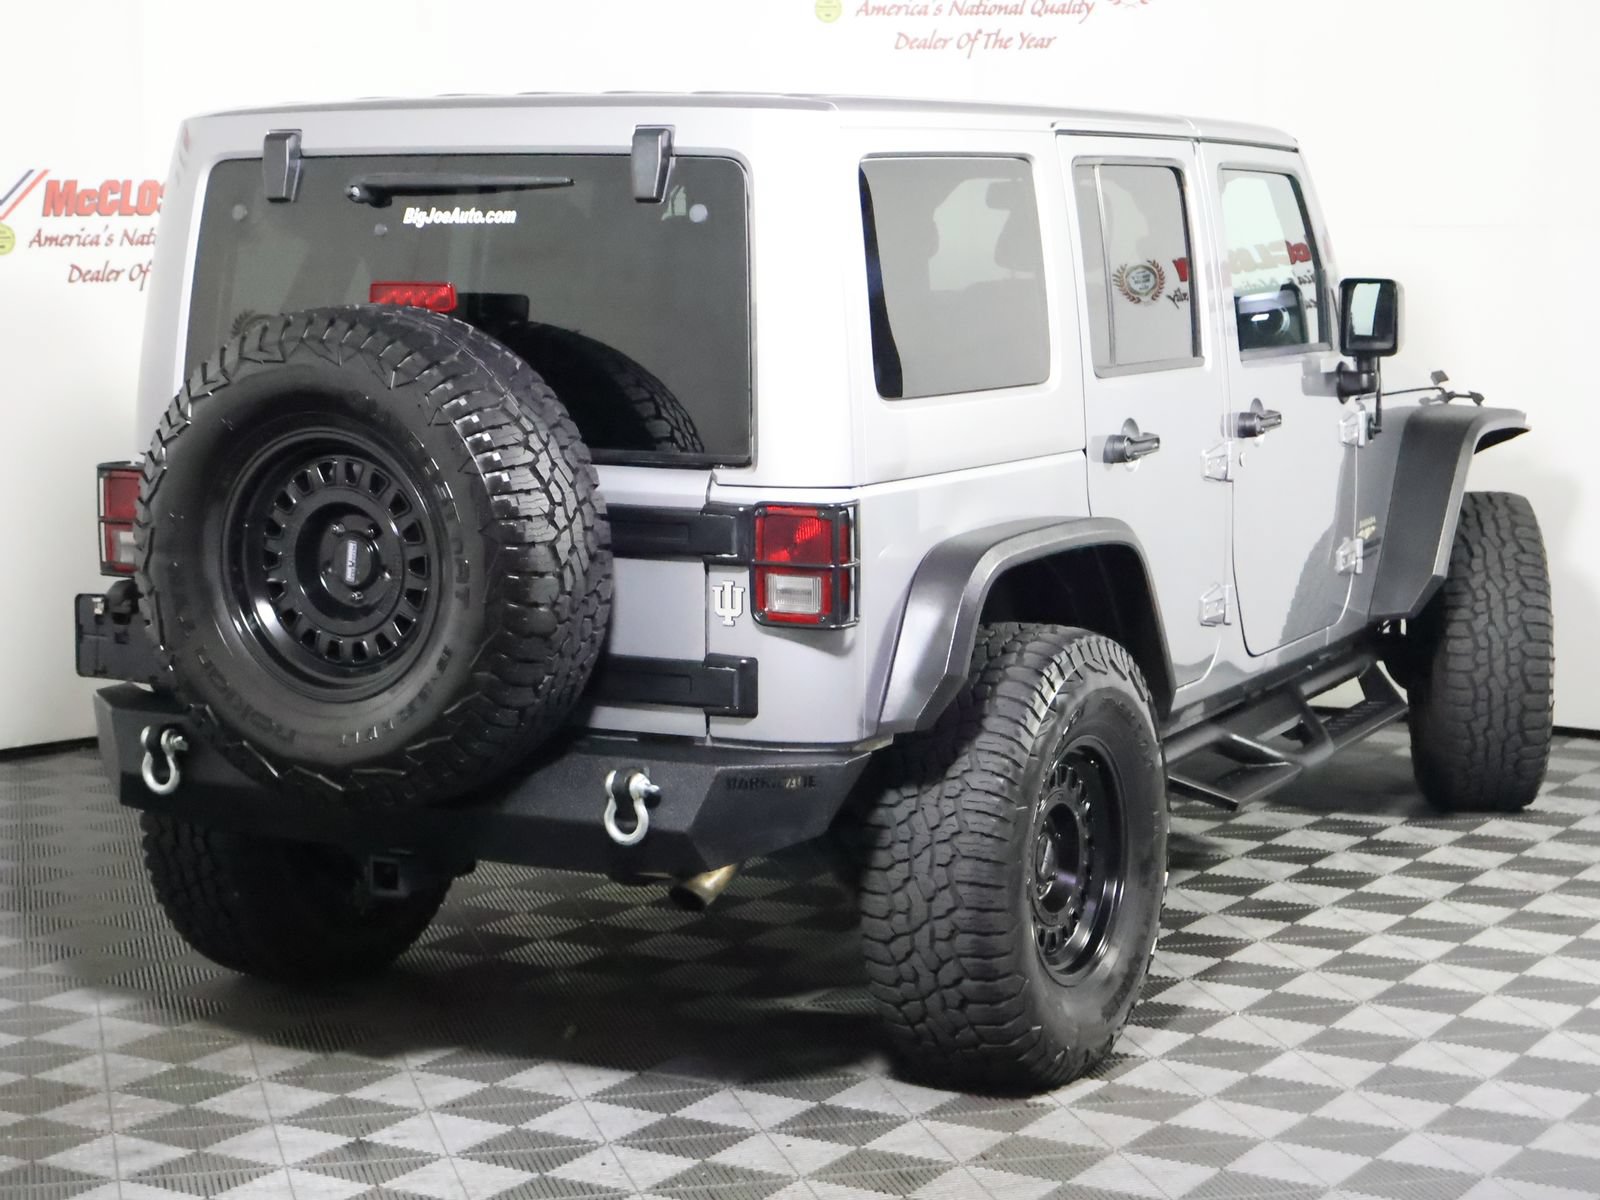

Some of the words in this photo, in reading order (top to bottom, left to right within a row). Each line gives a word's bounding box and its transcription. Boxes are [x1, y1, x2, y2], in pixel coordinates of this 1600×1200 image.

[855, 0, 942, 17] America's
[949, 0, 1025, 16] National
[1031, 0, 1095, 24] Quality
[894, 29, 951, 50] Dealer
[956, 29, 984, 59] Of
[982, 31, 1014, 50] The
[1018, 31, 1057, 50] Year
[42, 179, 166, 217] McCLO
[402, 206, 517, 228] BigJoeAuto.com
[29, 225, 114, 248] America's
[68, 260, 126, 283] Dealer
[129, 259, 153, 292] Of
